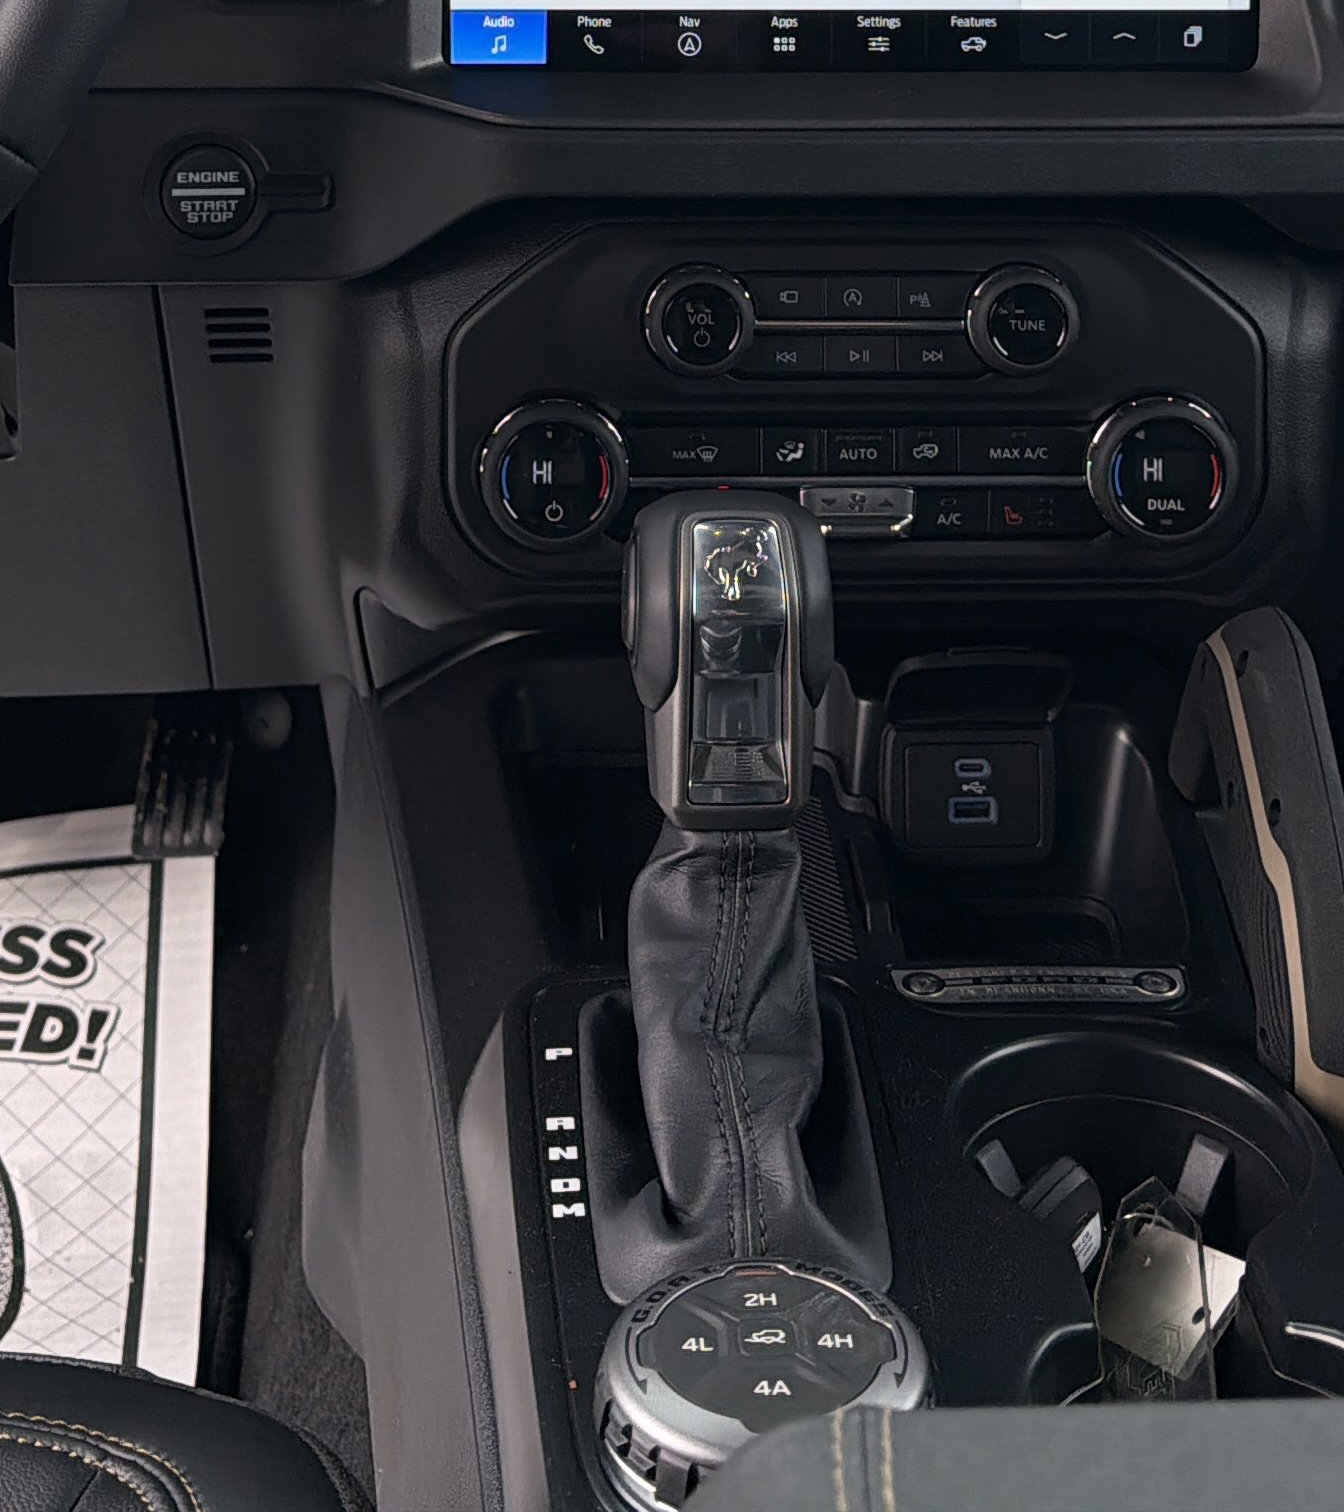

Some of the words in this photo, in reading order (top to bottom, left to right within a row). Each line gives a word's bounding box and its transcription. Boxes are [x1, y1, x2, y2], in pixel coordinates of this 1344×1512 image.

[482, 15, 515, 28] Audio
[577, 15, 612, 28] Phone
[679, 16, 700, 28] Nav
[771, 16, 799, 30] Apps
[857, 15, 901, 29] Settings
[950, 16, 997, 28] Features
[176, 171, 240, 184] ENGINE
[180, 199, 239, 213] START
[186, 211, 234, 224] STOP
[687, 313, 715, 326] VOL
[1009, 319, 1046, 332] TUNE
[839, 448, 878, 460] AUTO
[989, 447, 1019, 460] MAX
[1023, 447, 1048, 460] A/C
[532, 460, 552, 485] HI
[1143, 457, 1163, 483] HI
[1147, 498, 1185, 511] DUAL
[937, 512, 962, 526] A/C
[545, 1047, 573, 1060] P
[548, 1145, 578, 1160] N
[550, 1177, 581, 1192] D
[552, 1203, 585, 1218] M
[794, 1261, 896, 1319] MODES
[742, 1292, 778, 1307] 2H
[681, 1336, 714, 1352] 4L
[816, 1333, 854, 1349] 4H
[752, 1379, 792, 1396] 4A
